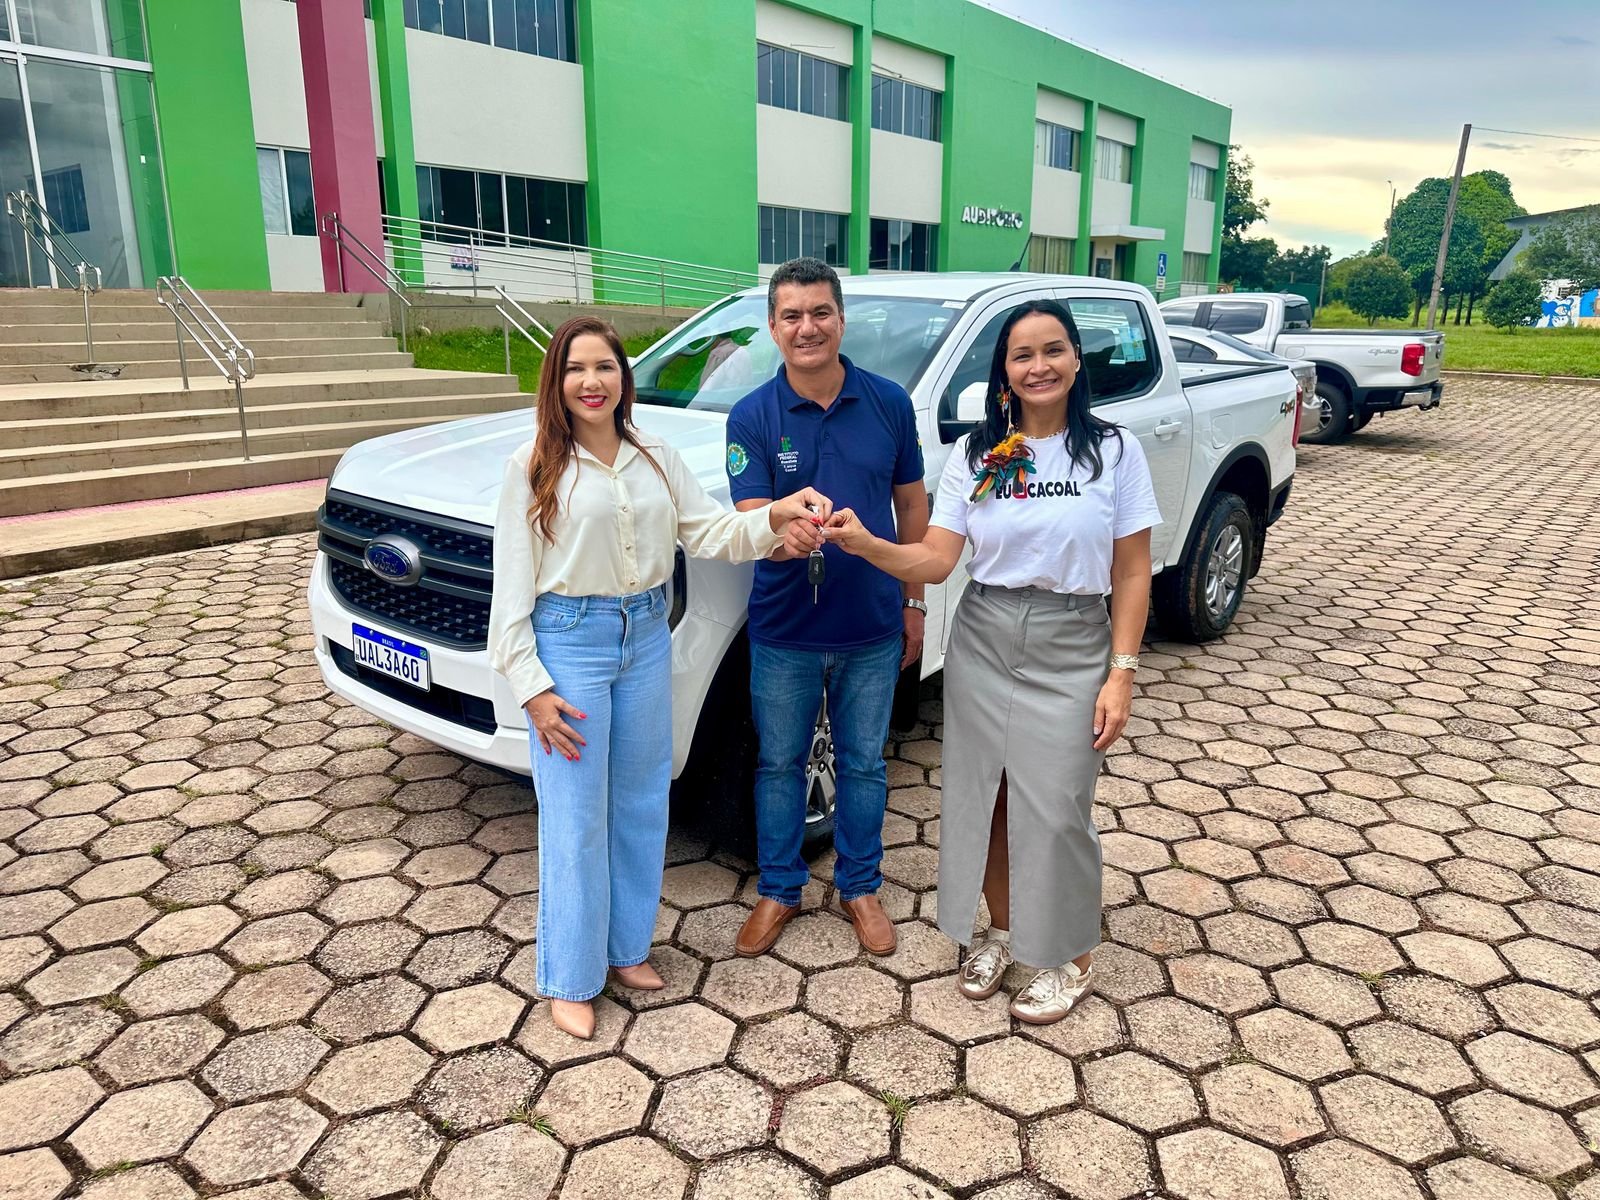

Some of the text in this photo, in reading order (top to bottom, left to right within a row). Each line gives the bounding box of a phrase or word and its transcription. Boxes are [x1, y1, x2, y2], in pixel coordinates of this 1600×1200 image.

[1027, 480, 1081, 498] CACOAL
[373, 550, 400, 574] Ford
[358, 638, 419, 682] UAL3A60
